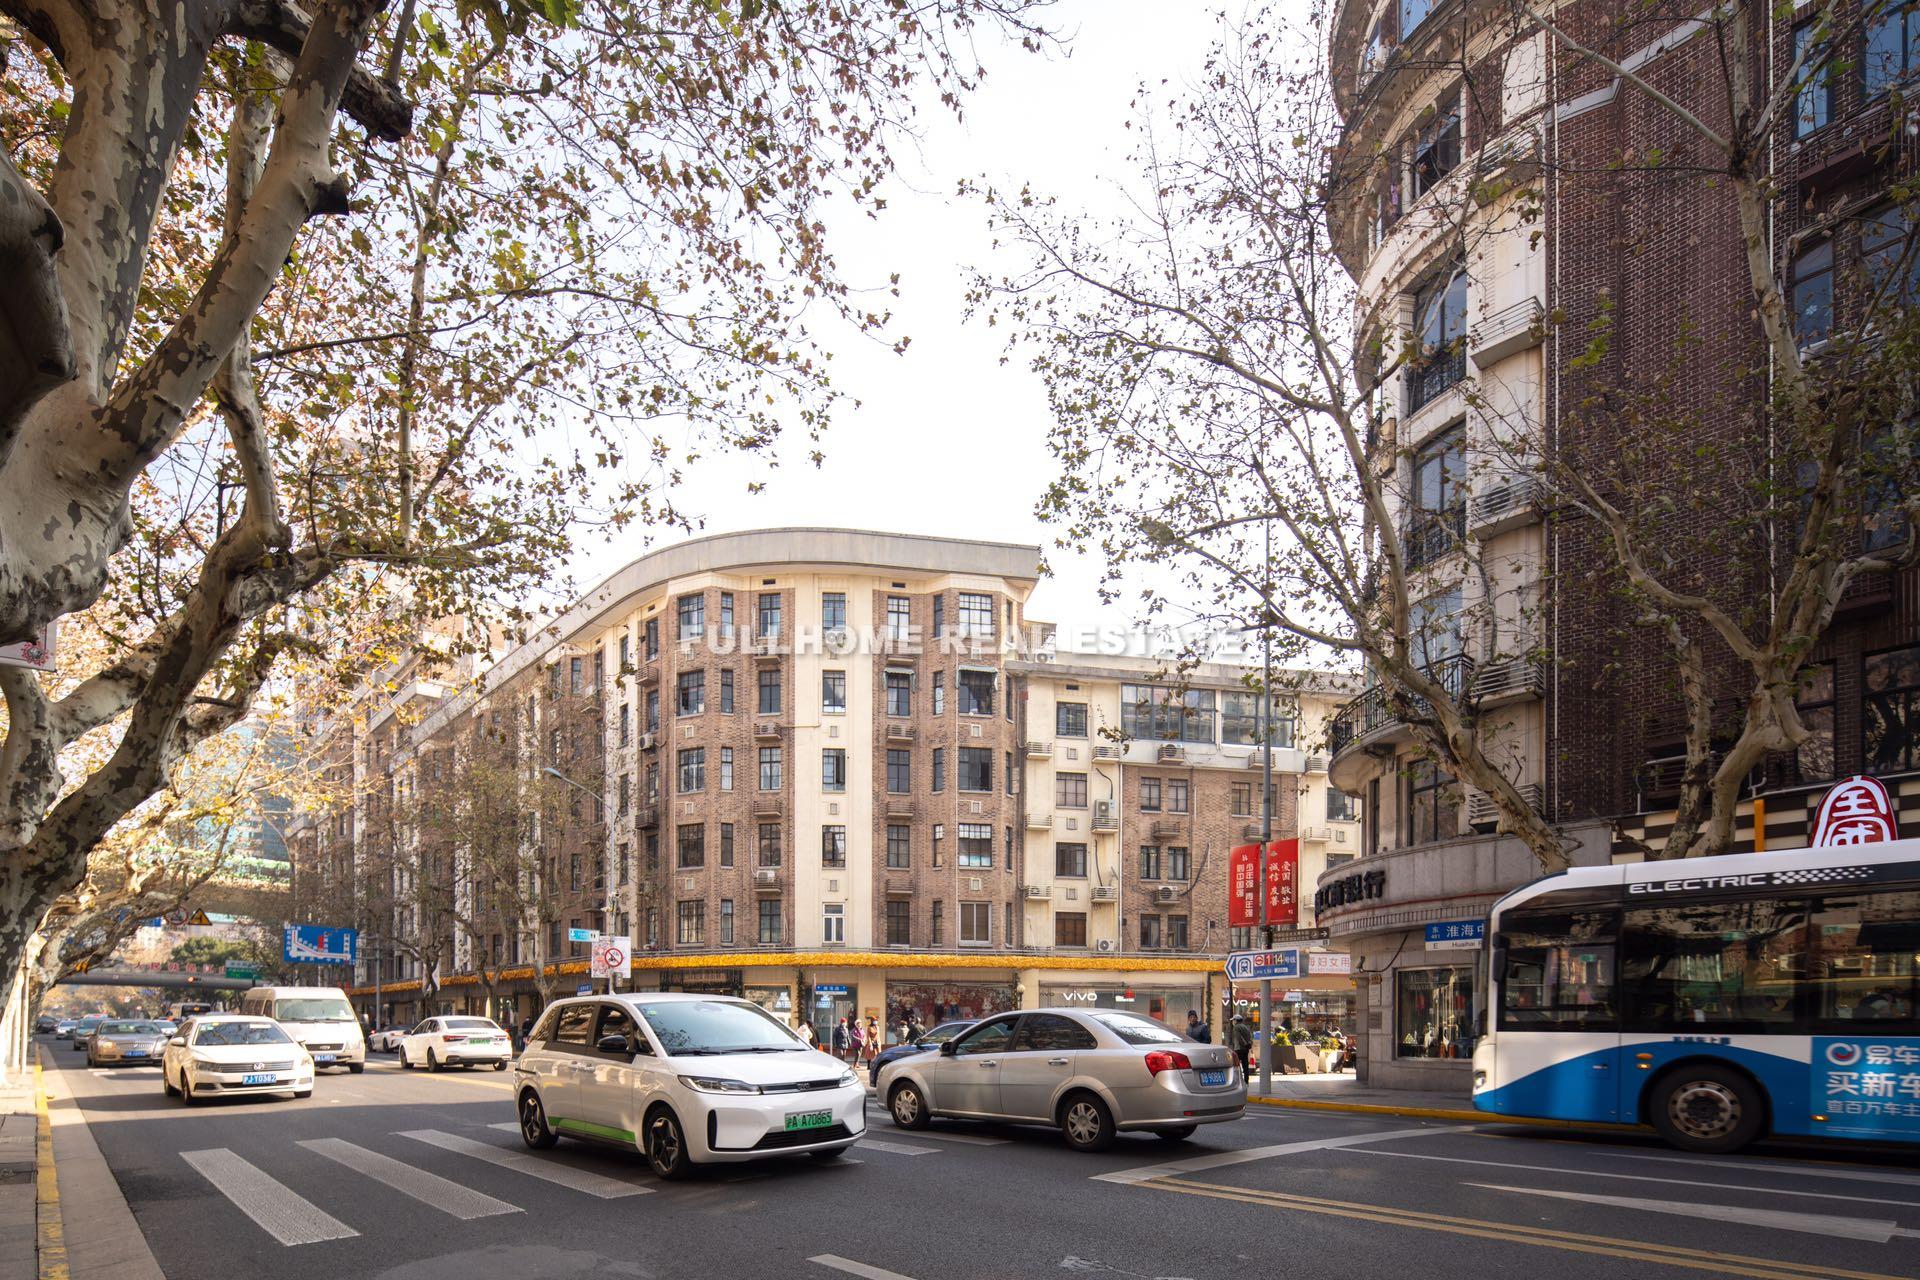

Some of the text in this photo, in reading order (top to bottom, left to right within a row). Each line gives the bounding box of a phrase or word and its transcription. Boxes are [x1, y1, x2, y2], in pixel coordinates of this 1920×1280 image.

[1628, 873, 1767, 895] ELECTRIC
[1063, 990, 1098, 1001] vivo
[1826, 1071, 1920, 1099] 买新车
